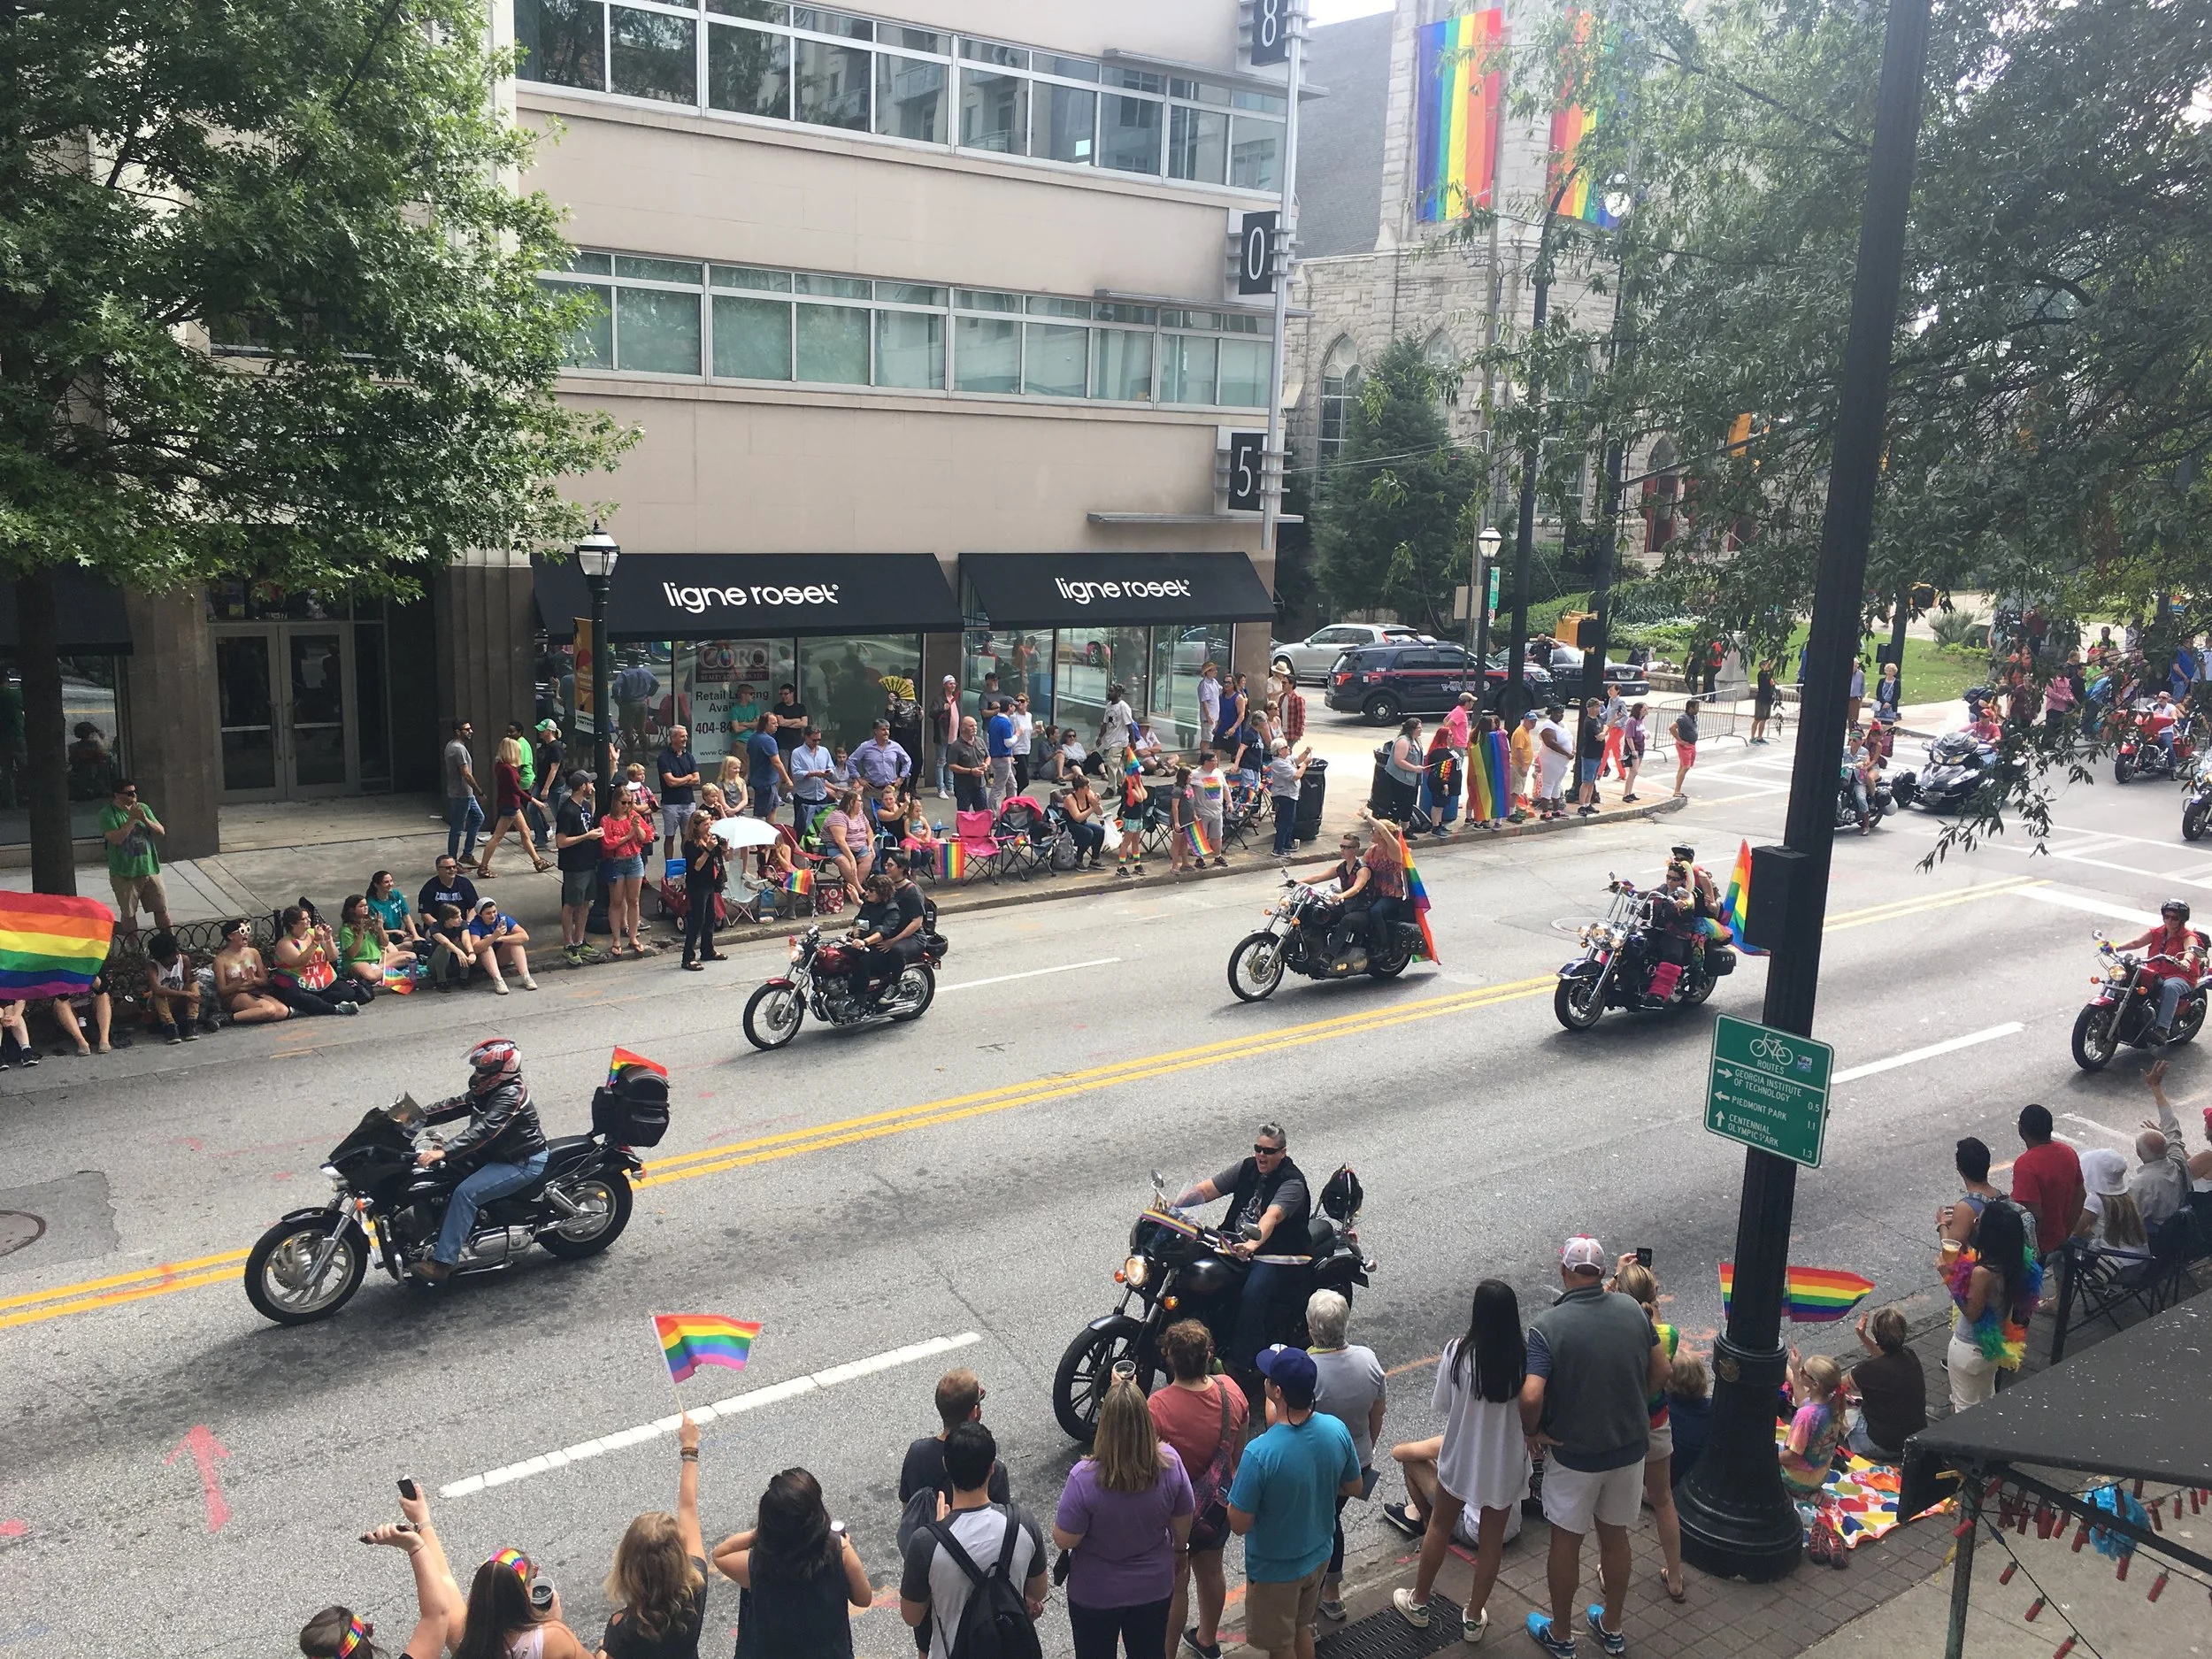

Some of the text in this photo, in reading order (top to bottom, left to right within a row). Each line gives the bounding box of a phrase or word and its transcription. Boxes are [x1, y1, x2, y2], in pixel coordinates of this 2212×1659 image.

[1262, 0, 1278, 47] 8
[1248, 227, 1264, 280] 0
[1237, 446, 1252, 497] 5
[663, 581, 748, 614] ligne
[1054, 577, 1121, 605] ligne
[695, 689, 726, 701] Retail
[298, 974, 325, 990] GAY
[1734, 1068, 1802, 1097] GEORGIA INSTITUTE
[1756, 1059, 1785, 1075] ROUTES
[1733, 1078, 1820, 1112] OF TECHNOLOGY 0.5
[1729, 1113, 1770, 1135] CENTENNIAL
[1732, 1095, 1816, 1131] PIEDMONT PARK 1.1
[1727, 1122, 1813, 1159] OLYMPIC PARK 1.3
